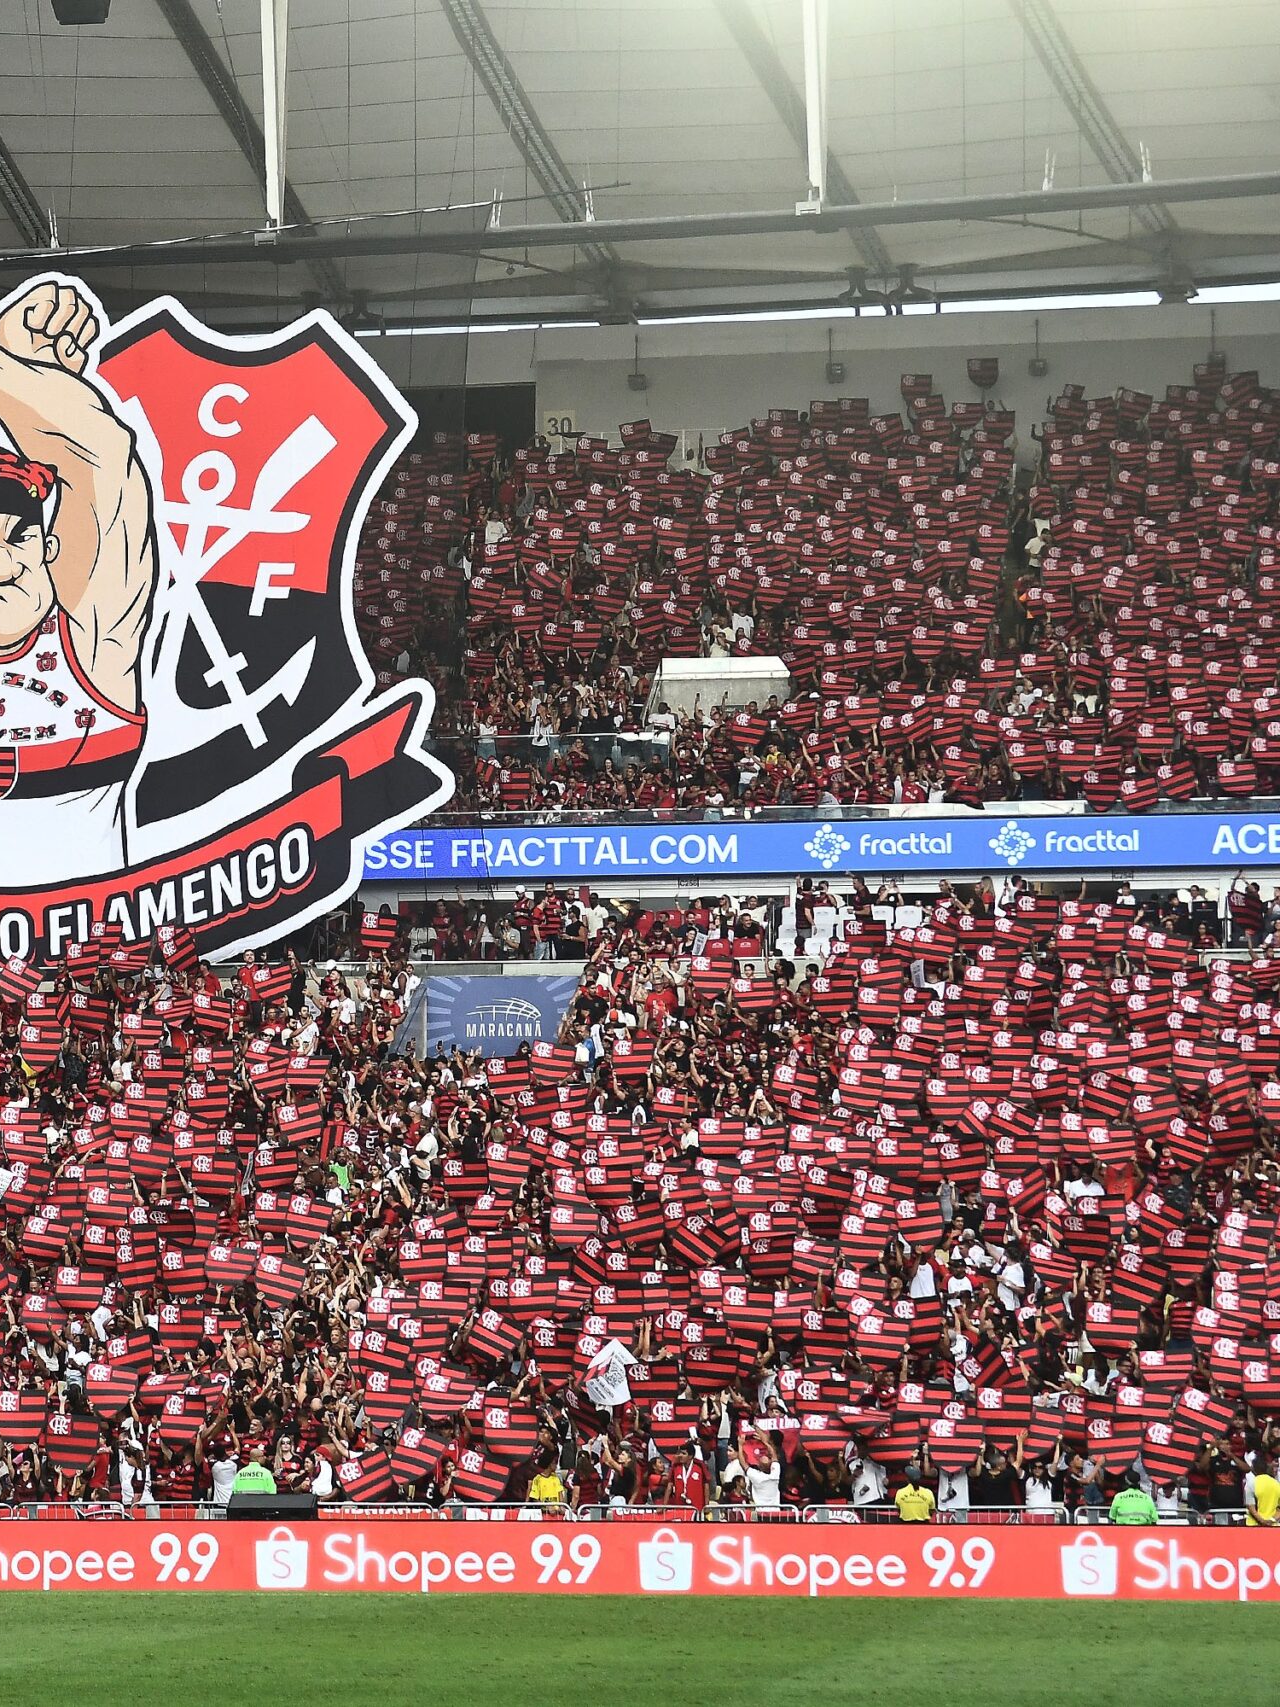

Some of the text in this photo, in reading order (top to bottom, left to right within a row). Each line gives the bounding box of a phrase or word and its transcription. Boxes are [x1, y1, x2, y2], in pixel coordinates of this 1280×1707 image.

[547, 416, 572, 436] 30
[451, 834, 738, 867] FRACTTAL.COM
[860, 832, 952, 855] fracttal
[1045, 829, 1139, 852] fracttal
[0, 912, 29, 960] O
[49, 827, 310, 956] FLAMENGO
[466, 1020, 542, 1037] MARACANÃ
[150, 1532, 219, 1582] 9.9
[323, 1533, 601, 1593] Shopee 9.9
[708, 1535, 995, 1597] Shopee 9.9
[1134, 1538, 1280, 1603] Shop
